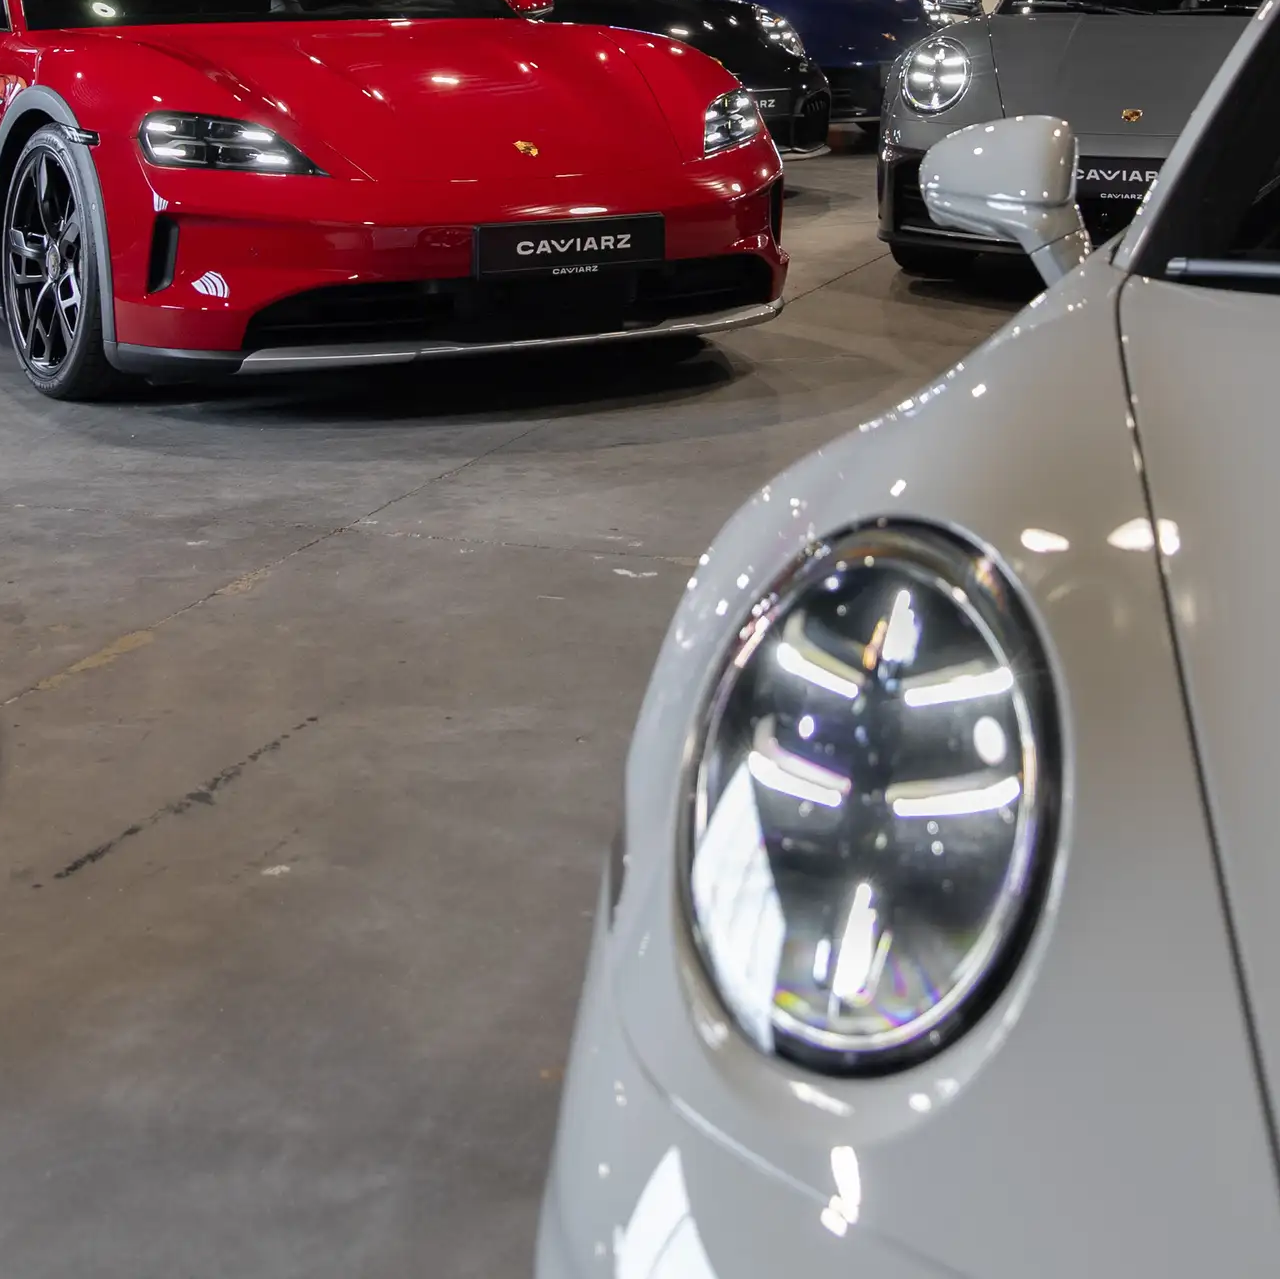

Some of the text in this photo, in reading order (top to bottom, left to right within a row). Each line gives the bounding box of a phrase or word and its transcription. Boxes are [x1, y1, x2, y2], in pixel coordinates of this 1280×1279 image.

[1075, 168, 1159, 182] CAVIAR
[1100, 192, 1143, 200] CAVIARZ
[516, 233, 632, 256] CAVIARZ
[552, 265, 599, 275] CAVIARZ
